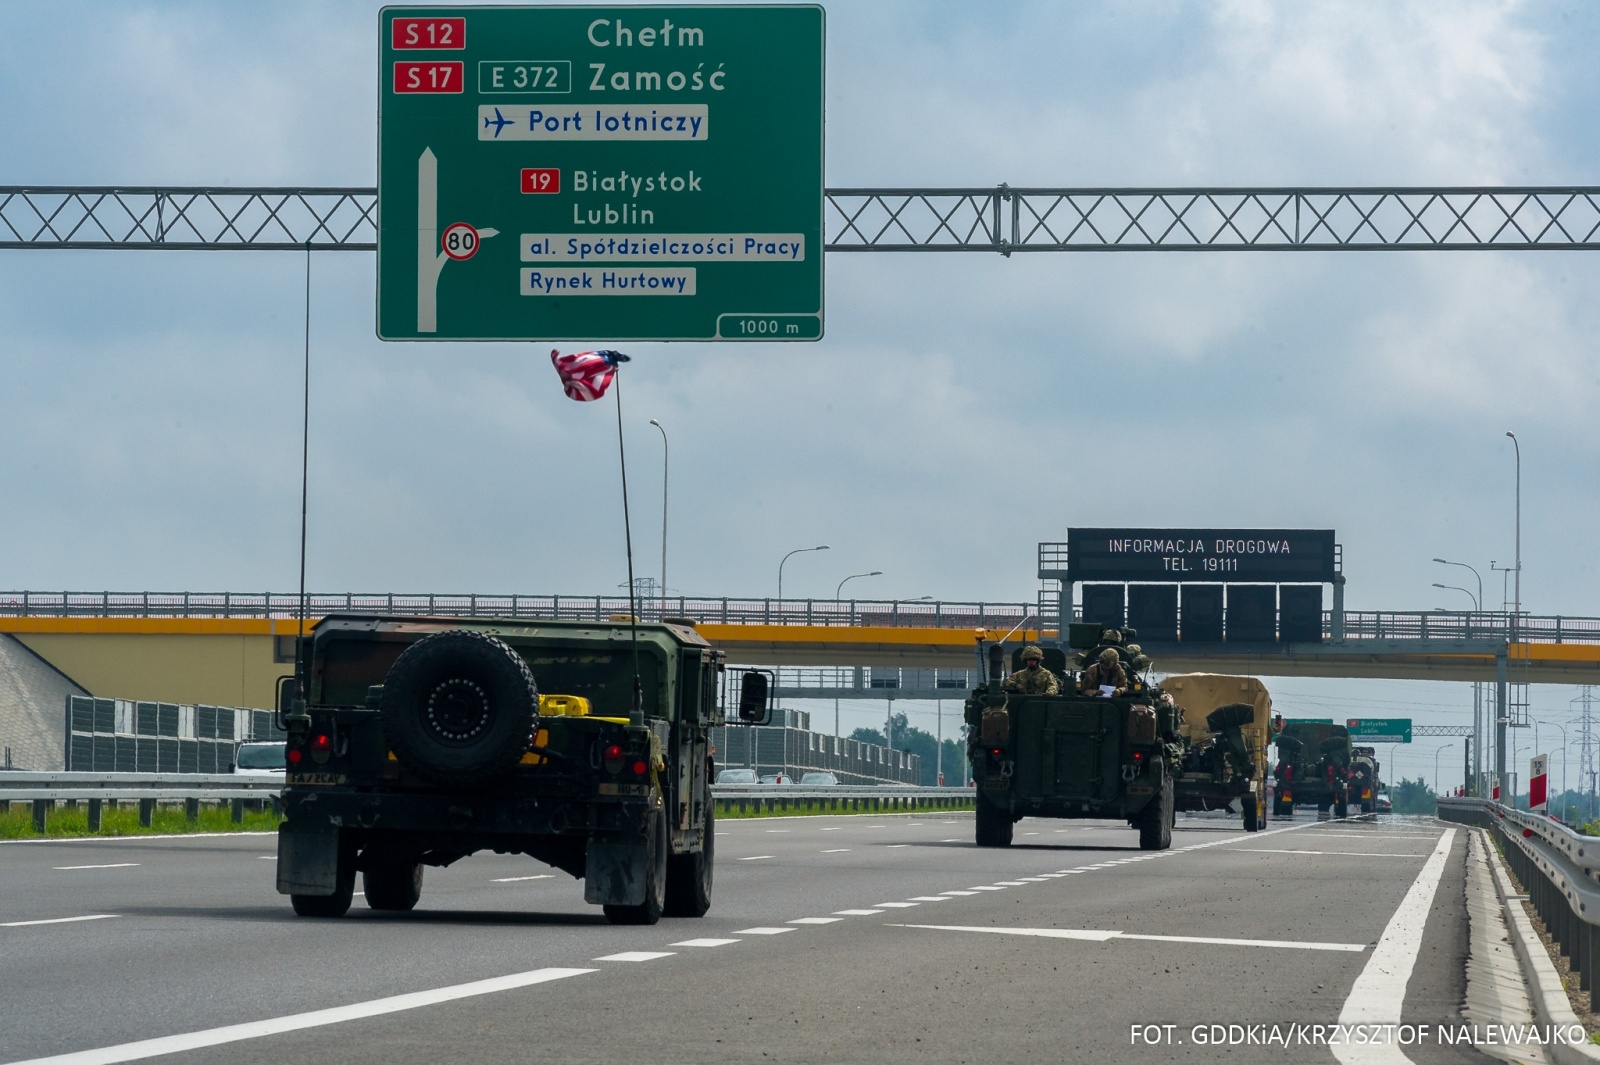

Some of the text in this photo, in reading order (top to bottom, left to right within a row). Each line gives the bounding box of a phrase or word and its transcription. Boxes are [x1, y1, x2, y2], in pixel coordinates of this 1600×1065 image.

[405, 23, 453, 45] S 12
[587, 19, 704, 47] Chełm
[406, 66, 453, 89] S 17
[492, 66, 558, 88] E 372
[588, 62, 727, 91] Zamość
[529, 110, 702, 137] Port lotniczy
[530, 173, 551, 190] 19
[574, 170, 702, 197] Białystok
[573, 204, 654, 225] Lublin
[447, 233, 475, 251] 80
[530, 239, 800, 260] al. Spółdzielczości Pracy
[530, 273, 687, 293] Rynek Hurtowy
[738, 320, 799, 335] 1000 m
[1109, 539, 1290, 554] INFORMACJA DROGOWA
[1162, 557, 1237, 571] TEL. 19111
